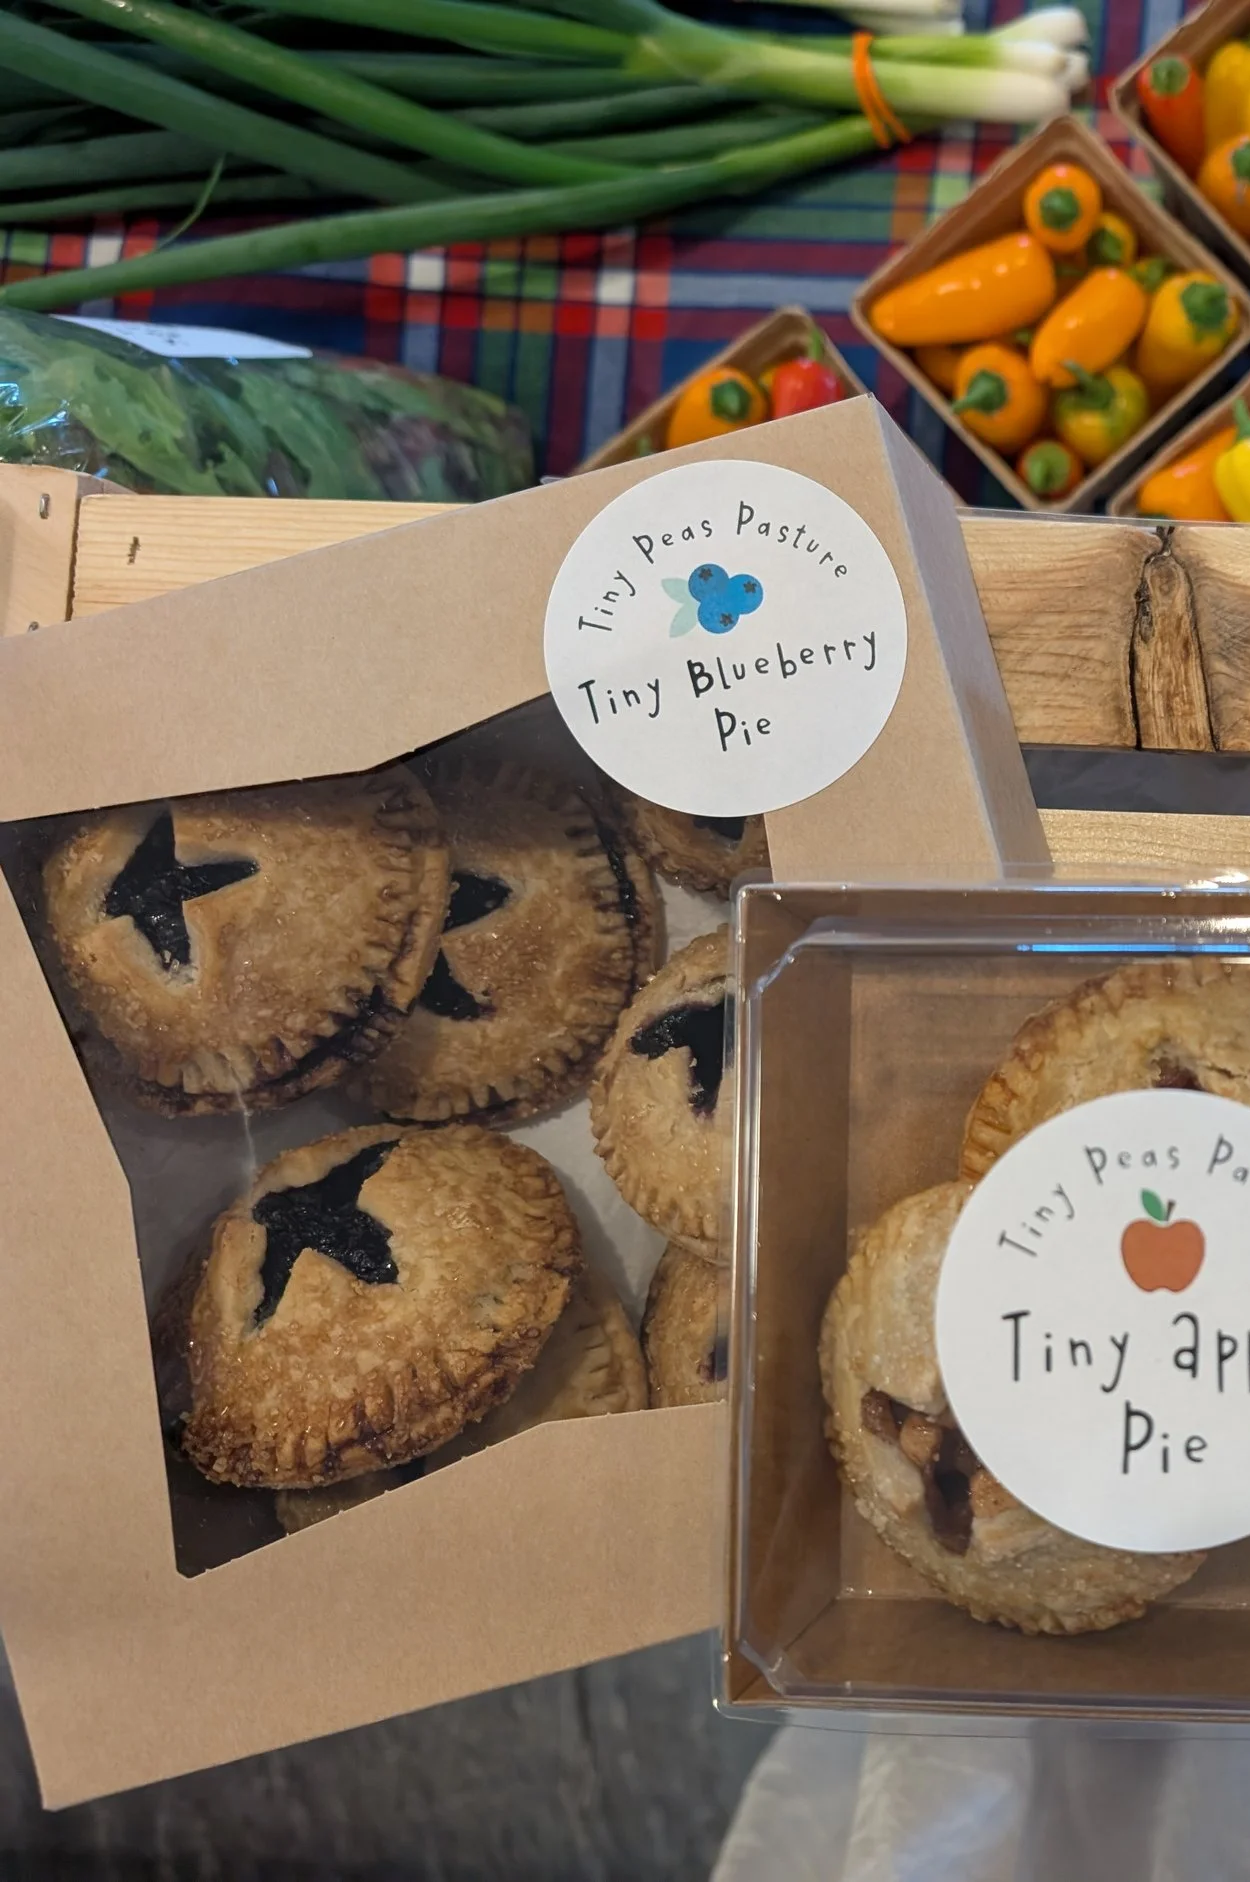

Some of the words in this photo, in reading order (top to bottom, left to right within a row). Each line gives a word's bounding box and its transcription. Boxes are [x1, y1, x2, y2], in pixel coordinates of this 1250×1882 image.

[577, 569, 637, 632] Tiny
[631, 519, 713, 565] Peas
[736, 500, 848, 578] Pasture
[577, 677, 660, 725] Tiny
[686, 630, 876, 699] Blueberry
[714, 707, 771, 753] Pie
[997, 1183, 1075, 1257] Tiny
[1084, 1146, 1180, 1185] Peas
[1000, 1309, 1130, 1395] Tiny
[1121, 1399, 1208, 1476] Pie
